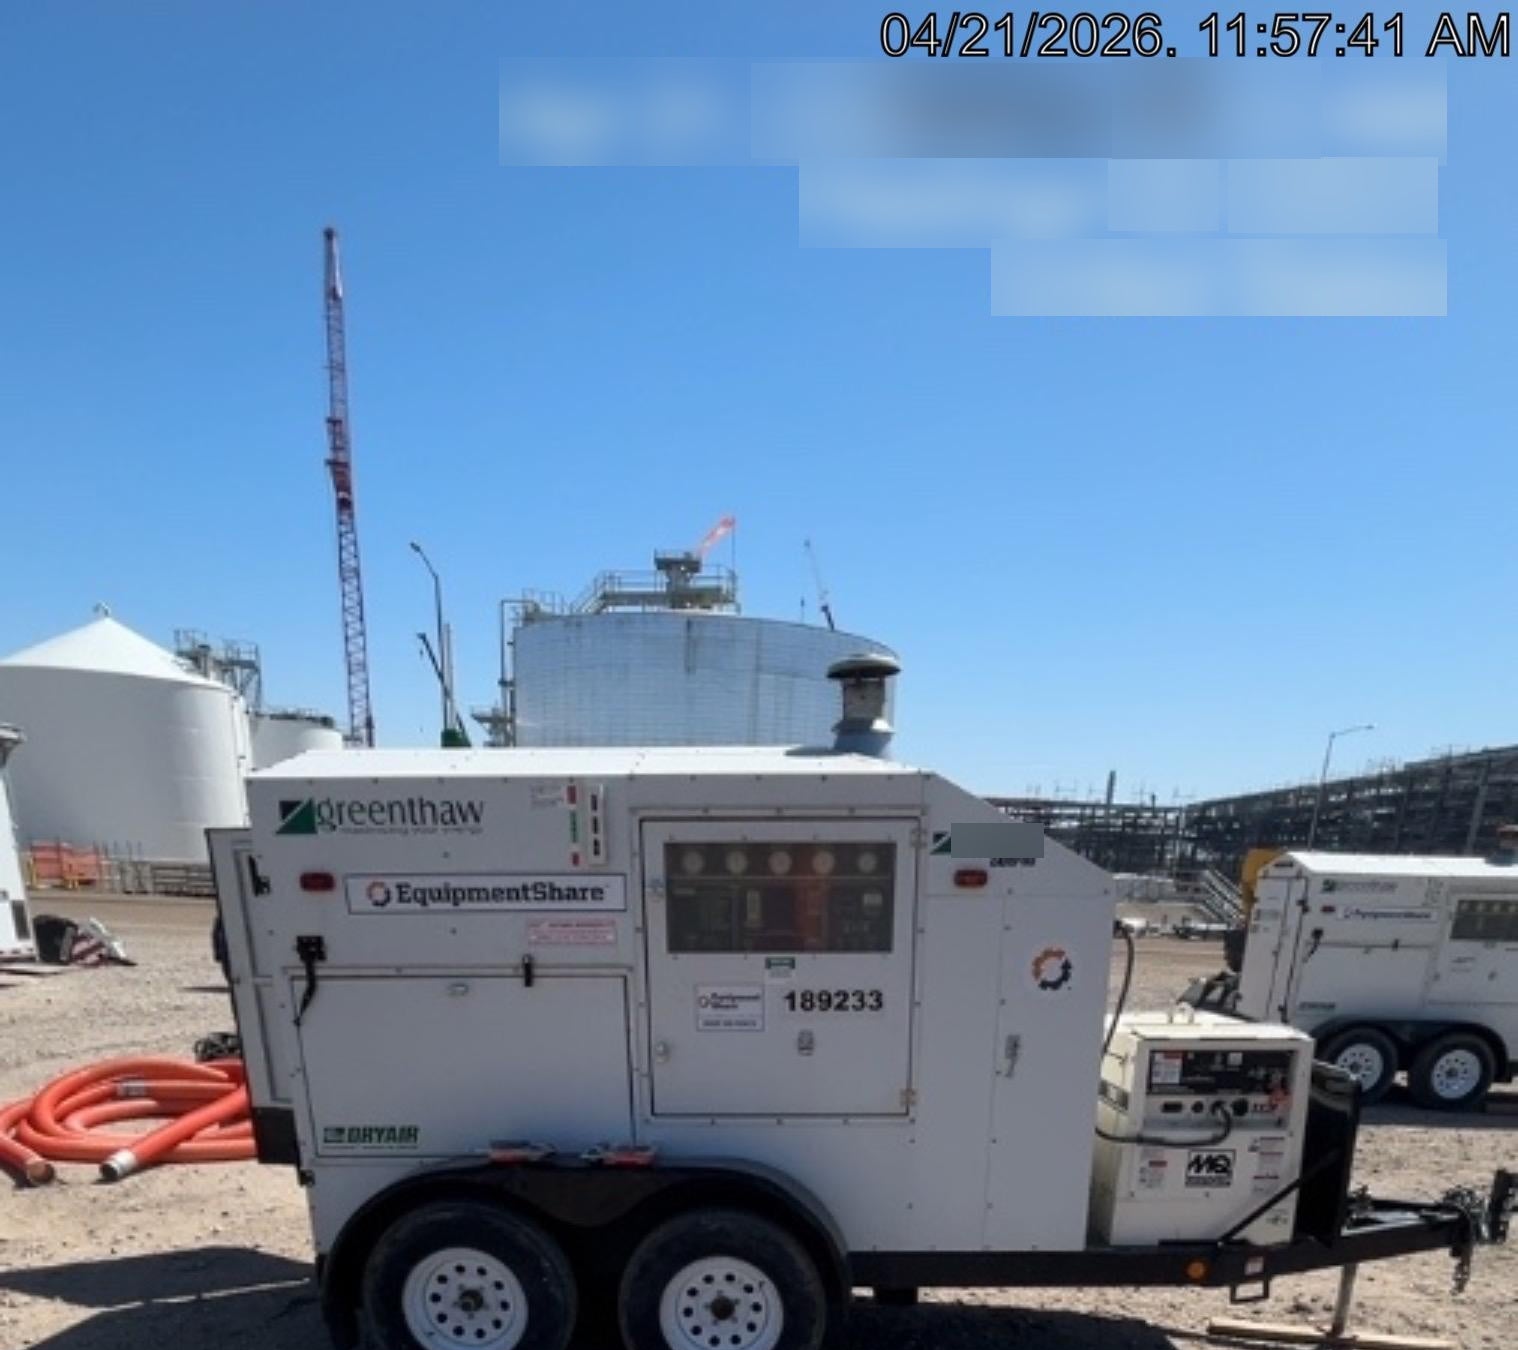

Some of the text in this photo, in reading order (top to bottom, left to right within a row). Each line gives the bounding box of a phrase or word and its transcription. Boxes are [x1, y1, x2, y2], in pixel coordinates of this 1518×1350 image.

[317, 796, 484, 832] greenthaw
[395, 880, 604, 907] EquipmentShare
[784, 989, 884, 1012] 189233
[347, 1125, 419, 1144] DRYAIR
